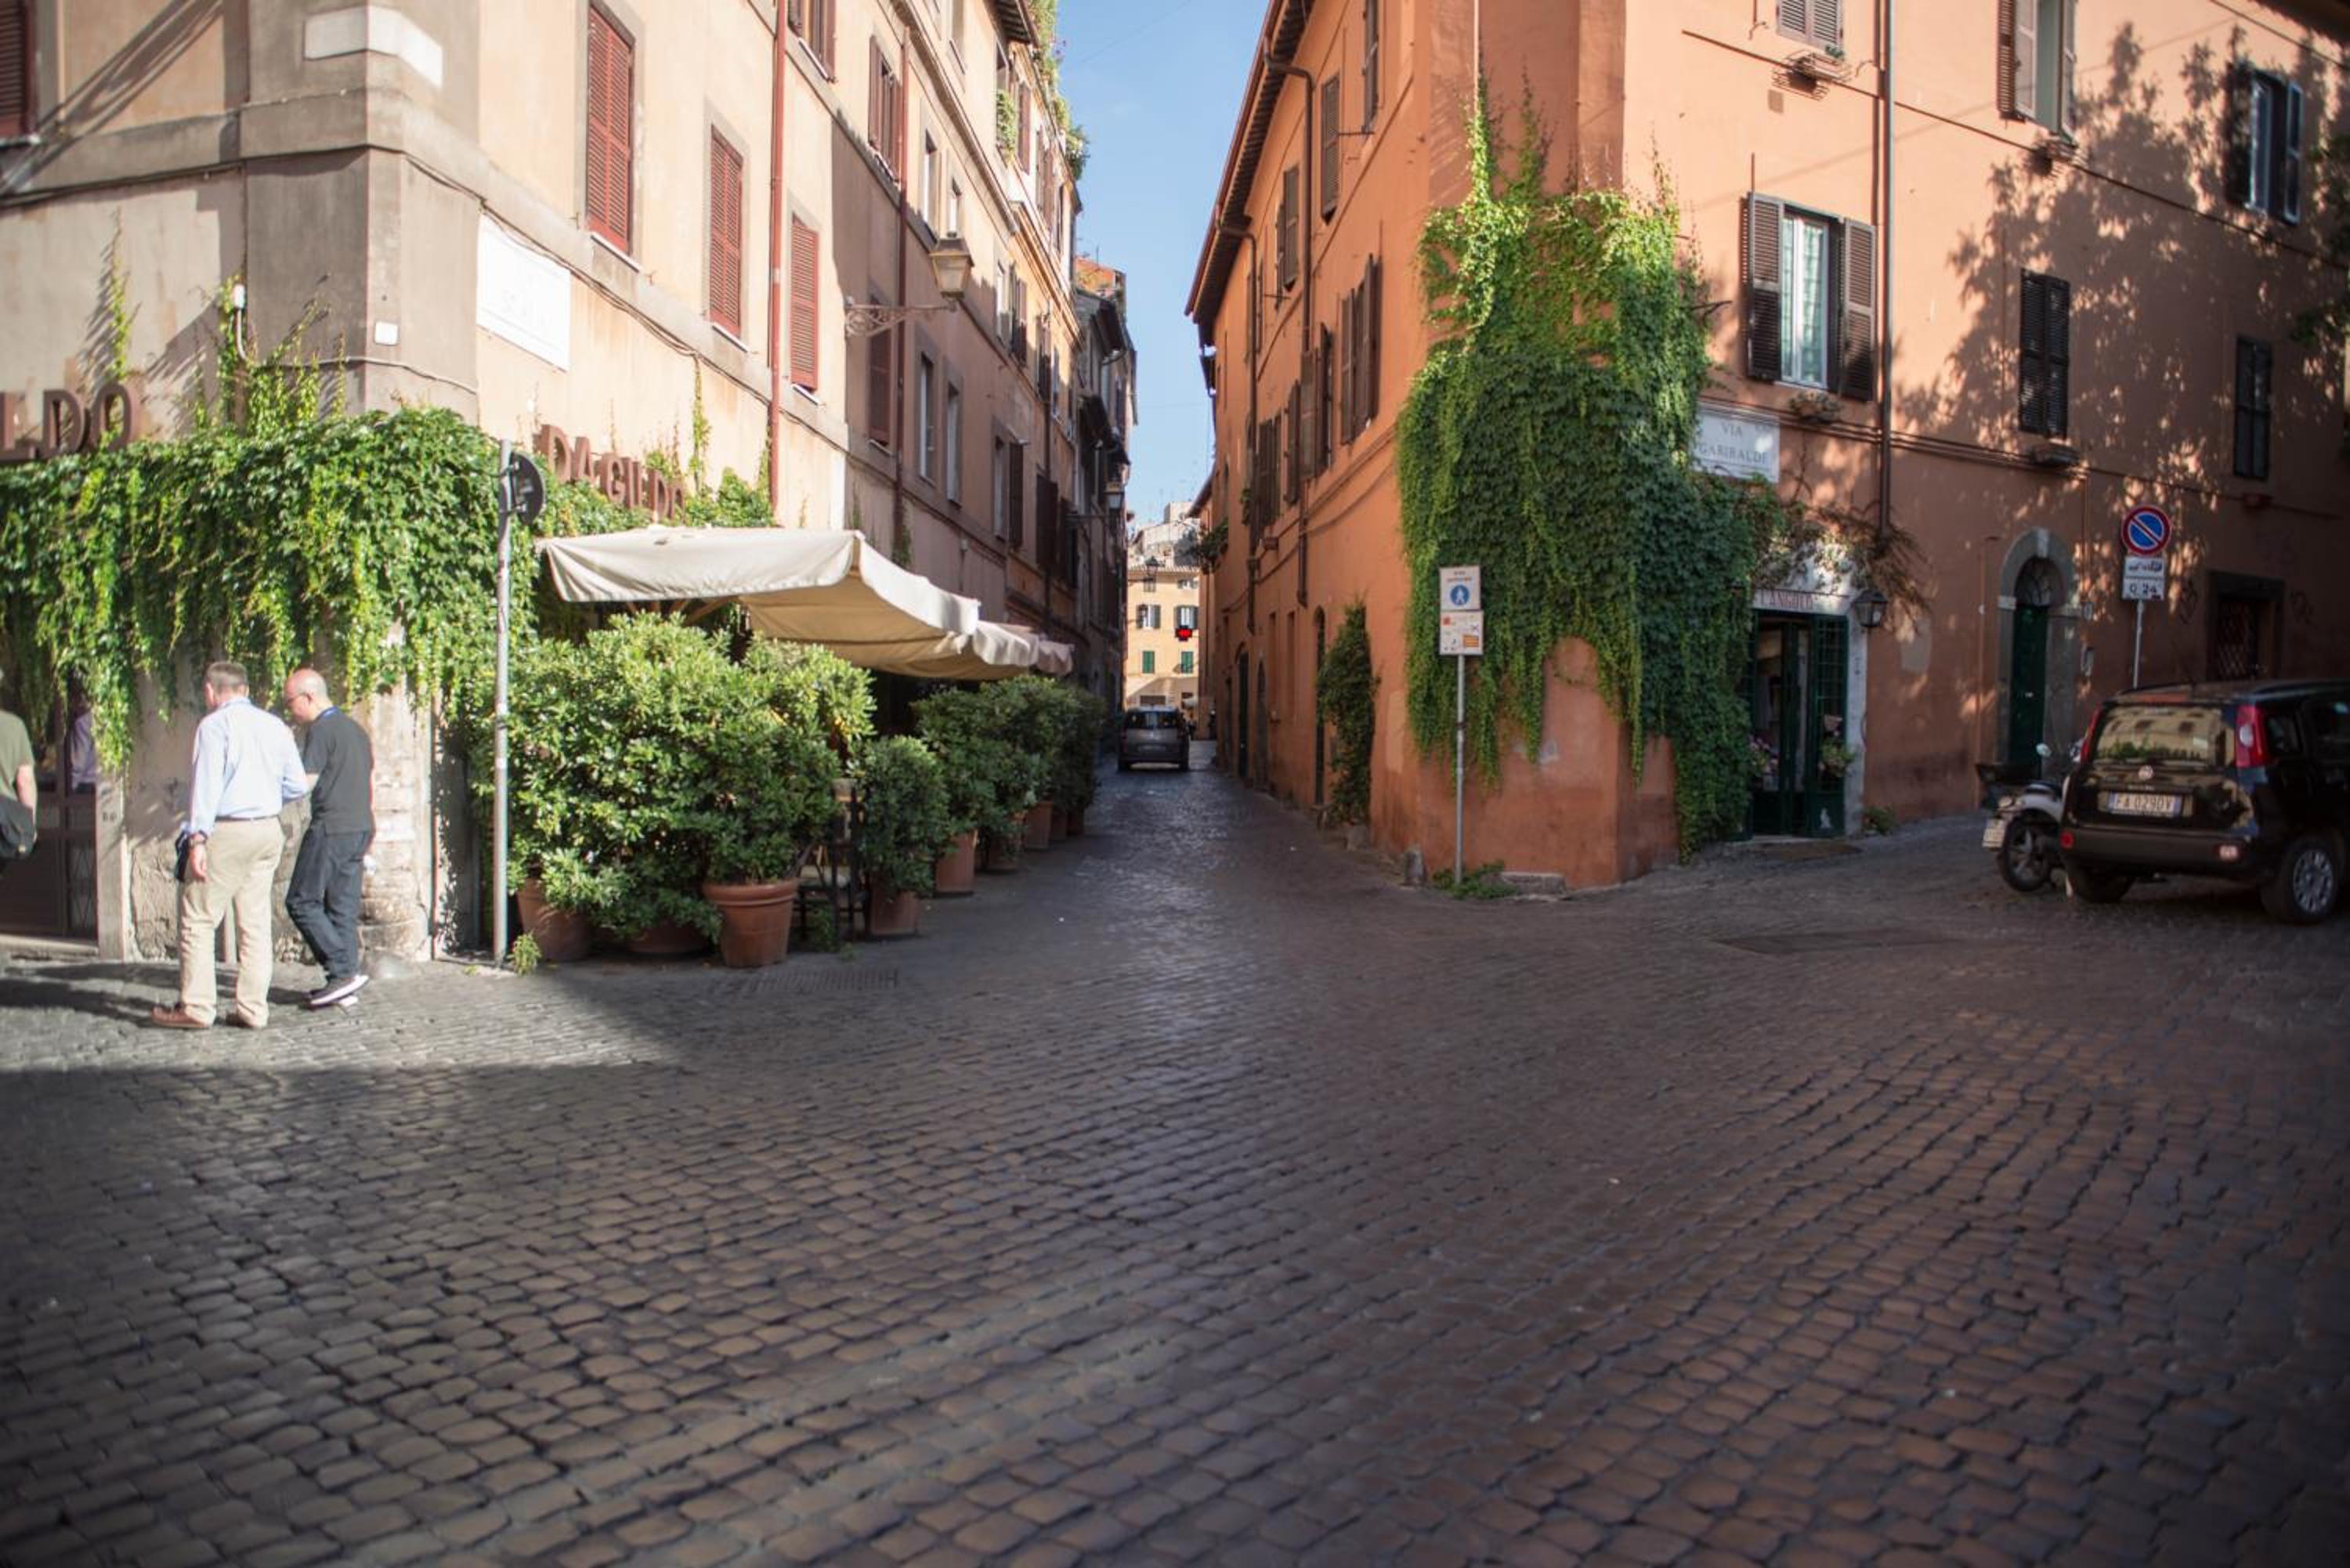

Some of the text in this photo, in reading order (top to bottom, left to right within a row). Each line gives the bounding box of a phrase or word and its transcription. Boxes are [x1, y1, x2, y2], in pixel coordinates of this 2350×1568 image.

[1721, 422, 1742, 436] VIA
[540, 425, 596, 484] DA
[1699, 445, 1767, 464] GARIBALDI
